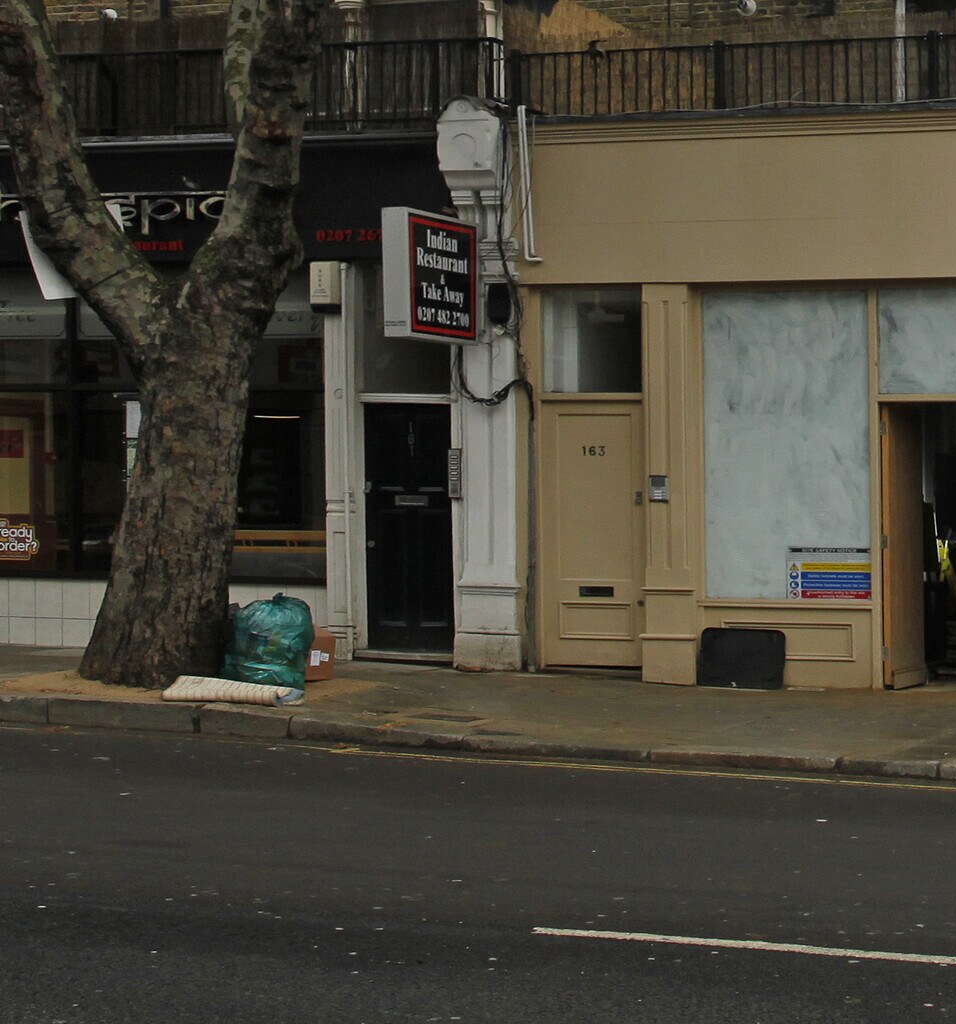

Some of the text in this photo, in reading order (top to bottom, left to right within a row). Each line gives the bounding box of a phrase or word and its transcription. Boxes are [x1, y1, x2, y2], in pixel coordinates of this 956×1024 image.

[315, 228, 353, 242] 0207
[426, 229, 458, 253] Indian
[416, 247, 468, 274] Restaurant
[421, 282, 464, 307] Take Away
[417, 306, 436, 323] 0207
[437, 309, 450, 325] 482
[582, 445, 606, 457] 163
[0, 527, 33, 542] eady
